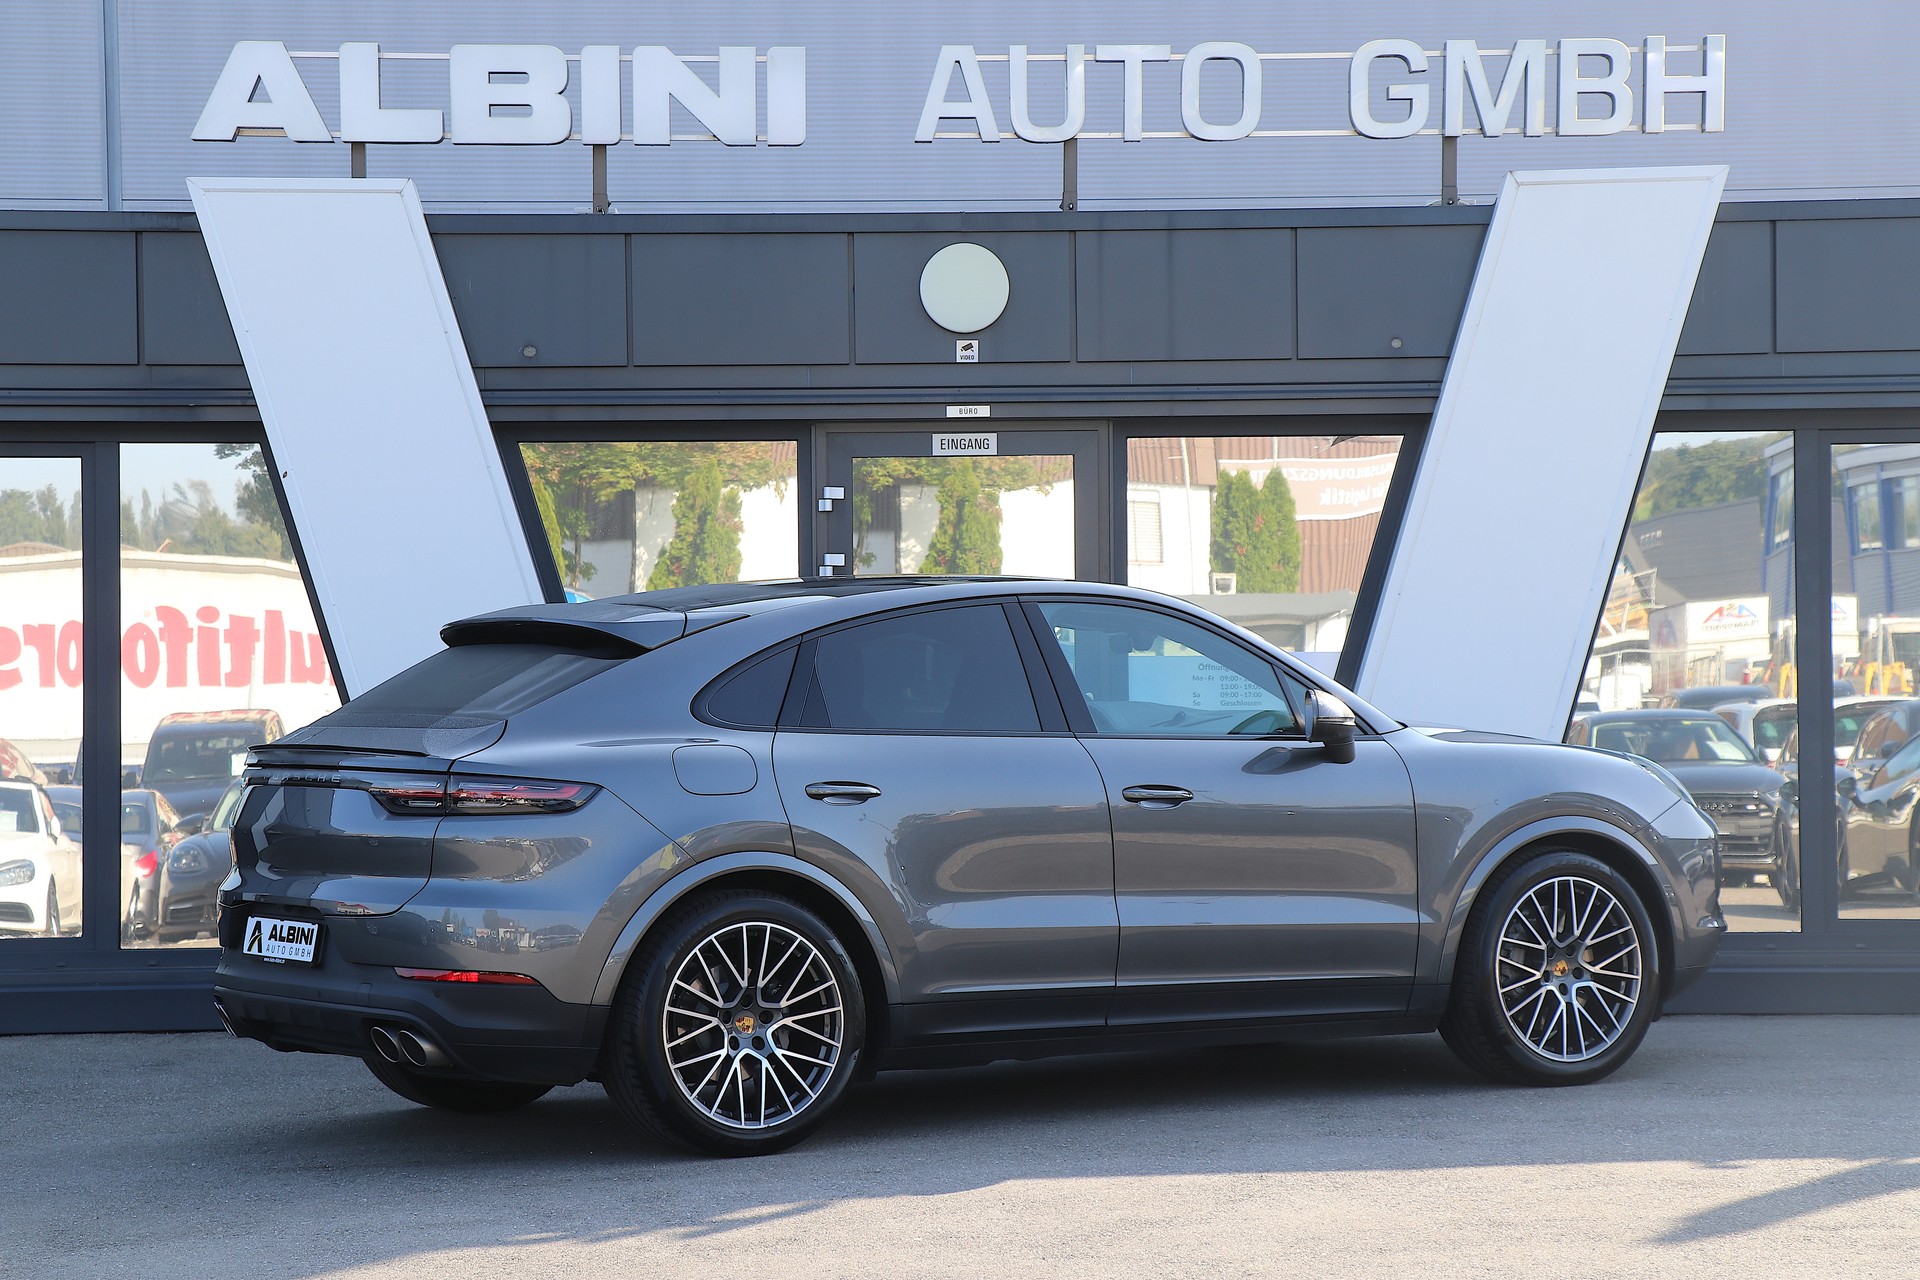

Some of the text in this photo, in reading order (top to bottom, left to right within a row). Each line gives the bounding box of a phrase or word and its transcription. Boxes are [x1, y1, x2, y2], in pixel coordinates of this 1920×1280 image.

[191, 34, 1726, 146] ALBINI AUTO GMBH
[958, 406, 979, 415] BÜRO
[940, 438, 990, 450] EINGANG
[267, 923, 315, 946] ALBINI
[265, 943, 312, 958] AUTO GMBH
